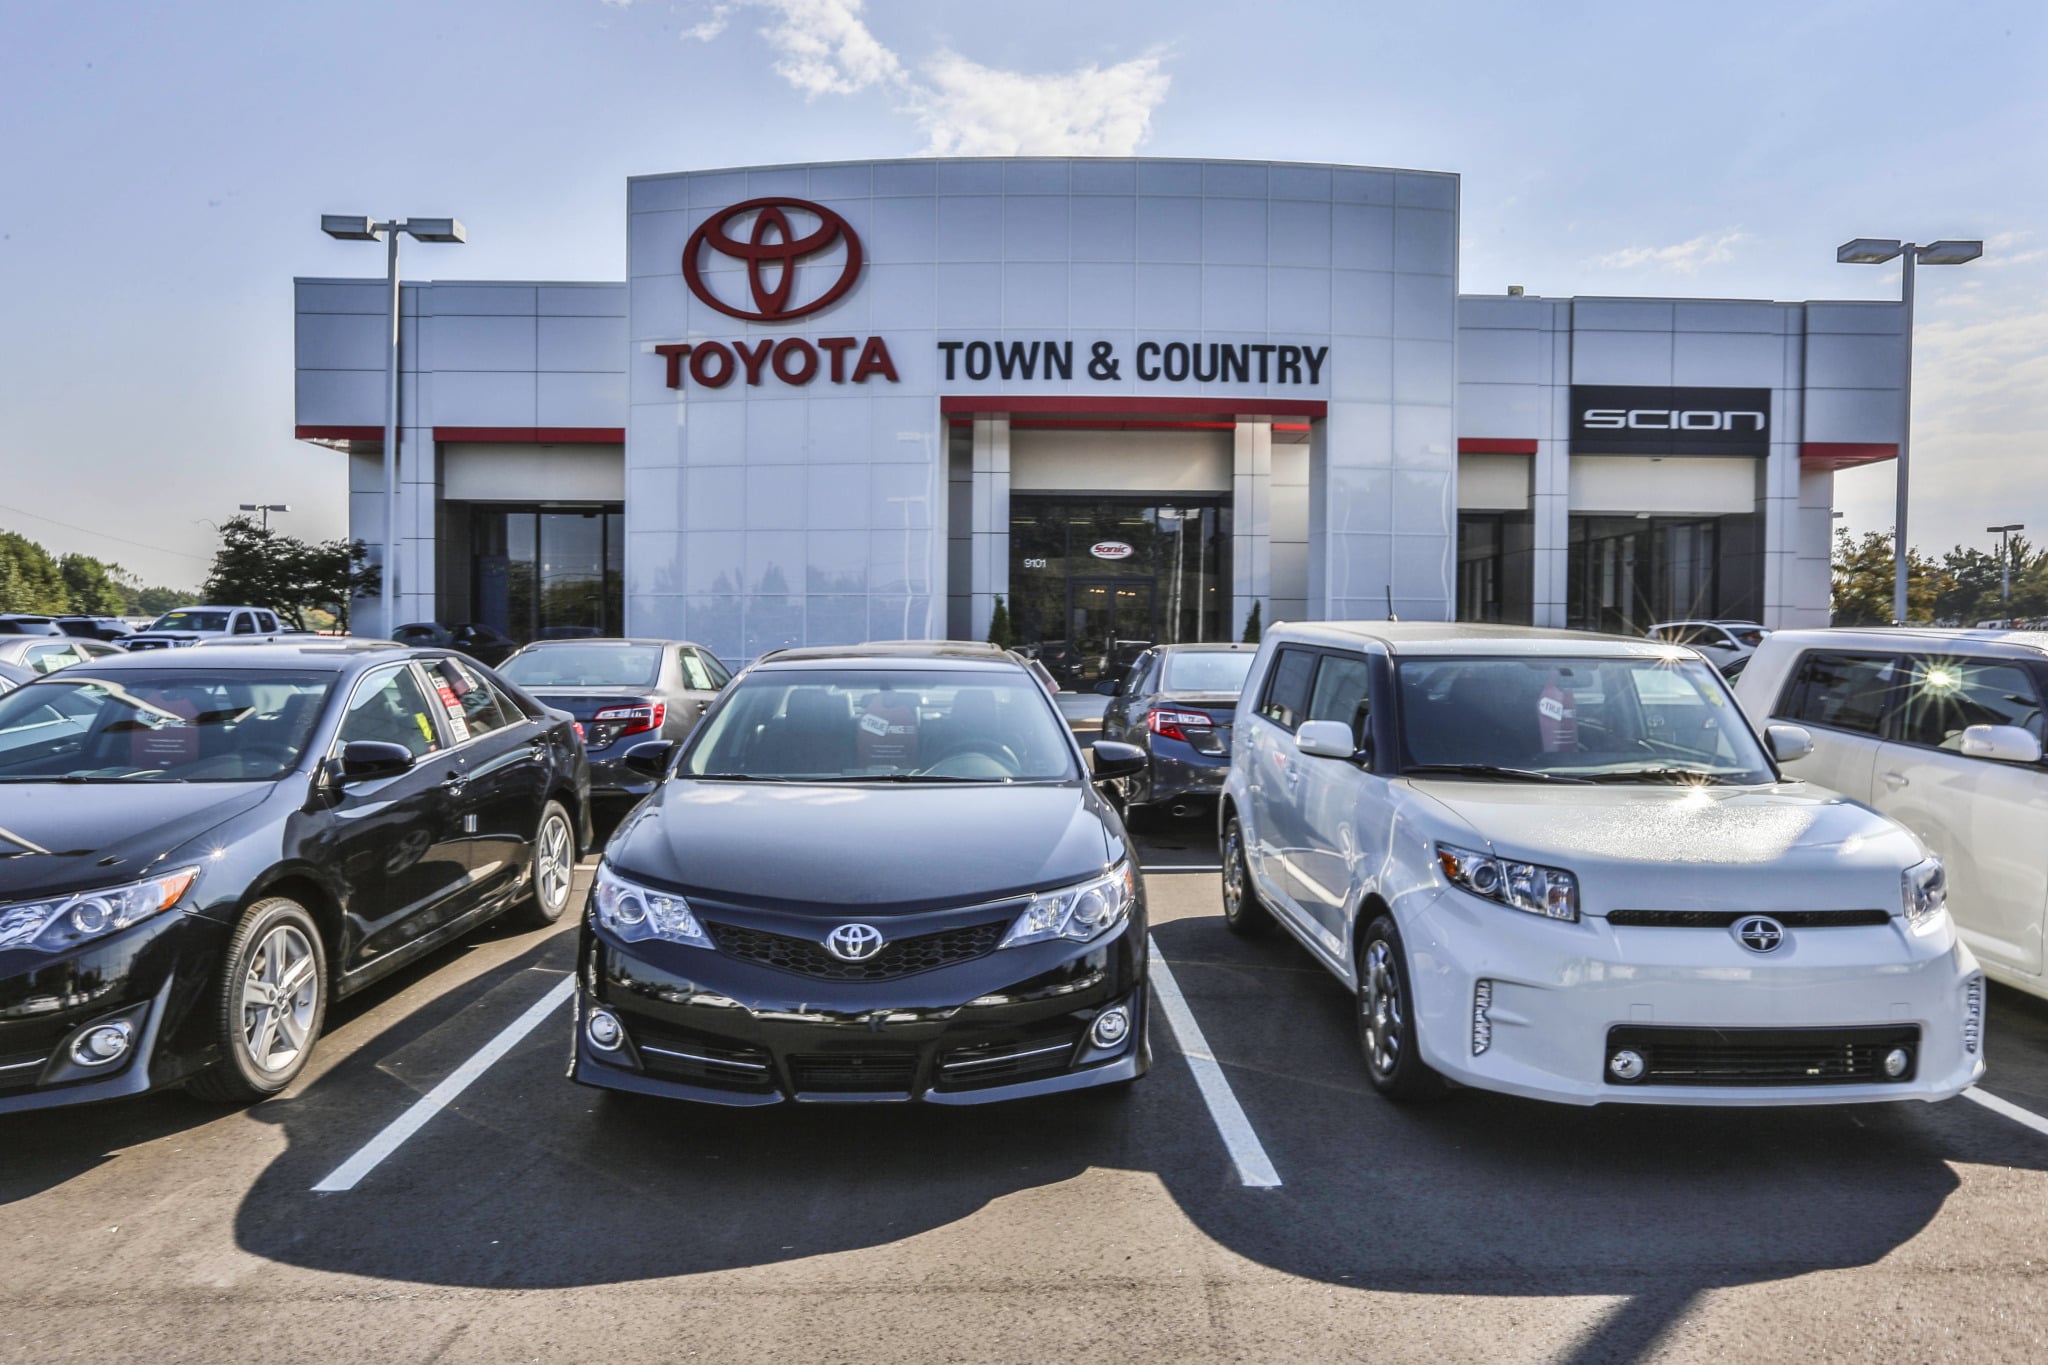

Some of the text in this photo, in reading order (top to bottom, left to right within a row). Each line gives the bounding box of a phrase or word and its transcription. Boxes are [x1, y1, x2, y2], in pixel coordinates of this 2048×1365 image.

[655, 336, 900, 388] TOYOTA
[938, 341, 1329, 384] TOWN & COUNTRY
[1095, 545, 1128, 553] Sonic
[1024, 559, 1046, 568] 9101
